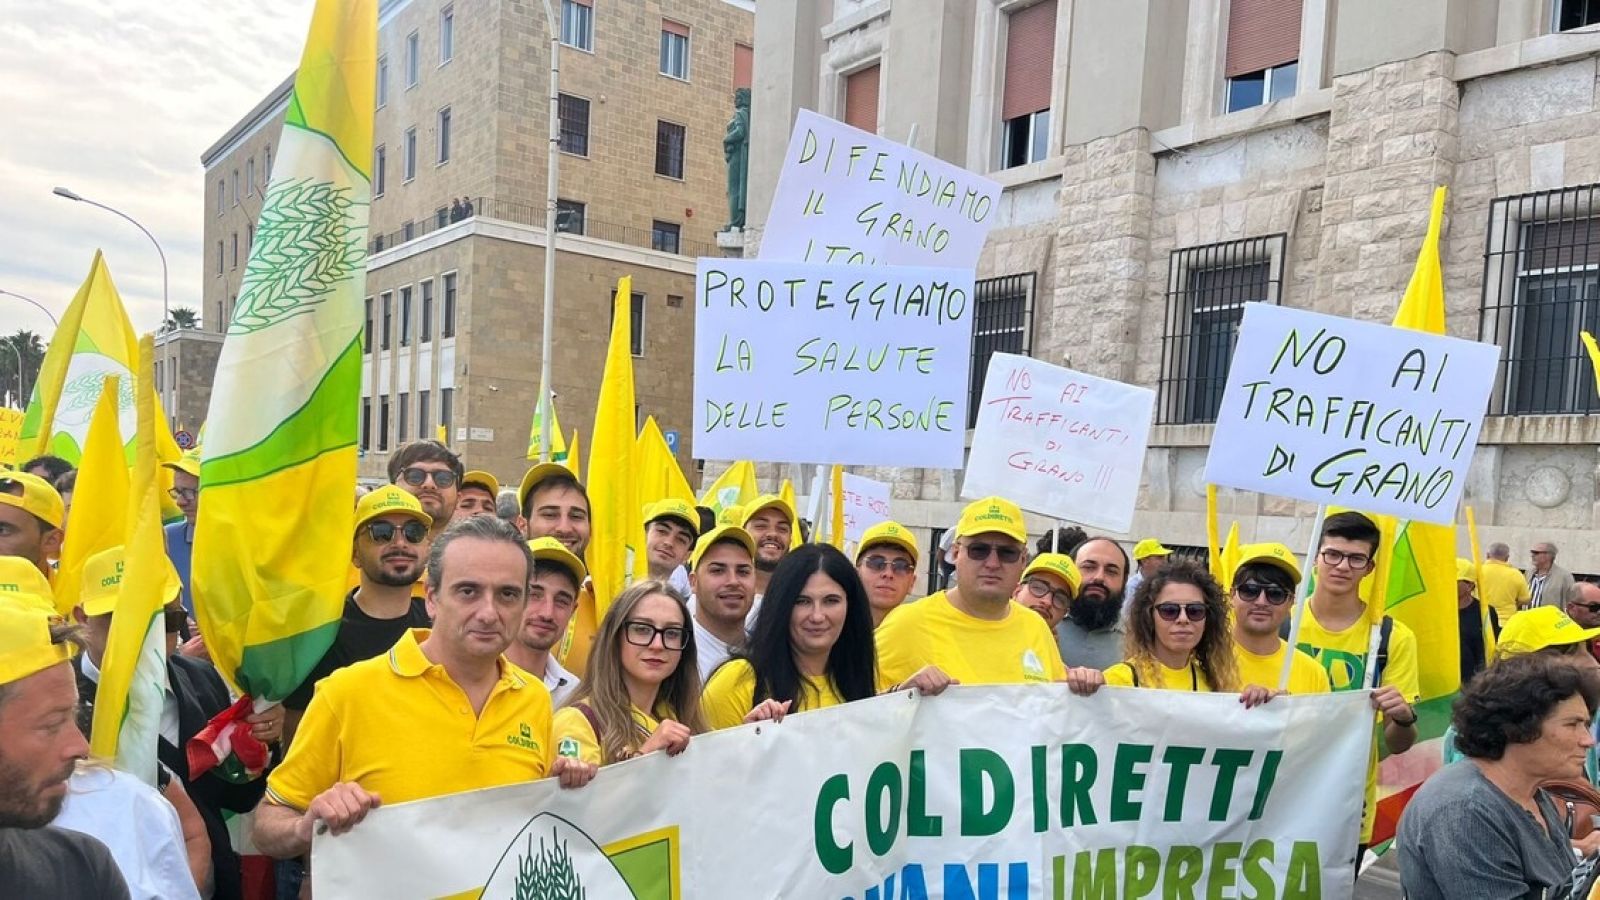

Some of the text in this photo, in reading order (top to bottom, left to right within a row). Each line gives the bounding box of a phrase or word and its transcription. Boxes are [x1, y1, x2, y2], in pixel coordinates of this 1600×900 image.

[798, 128, 992, 223] DIFENDIAMO
[803, 189, 950, 253] IL GRANO
[703, 270, 966, 325] PROTEGGIAMO
[716, 334, 936, 376] LA SALUTE
[1269, 328, 1448, 393] NO AI
[706, 394, 954, 433] DELLE PERSONE
[1005, 366, 1089, 404] NO AI
[987, 396, 1130, 445] TRAFFICANTI
[1045, 440, 1062, 450] DI
[1242, 381, 1472, 460] TRAFFICANTI
[1007, 451, 1085, 483] GRANO
[1262, 444, 1455, 509] DI GRANO
[814, 743, 1283, 874] COLDIRETTI
[1052, 838, 1322, 900] IMPRESA
